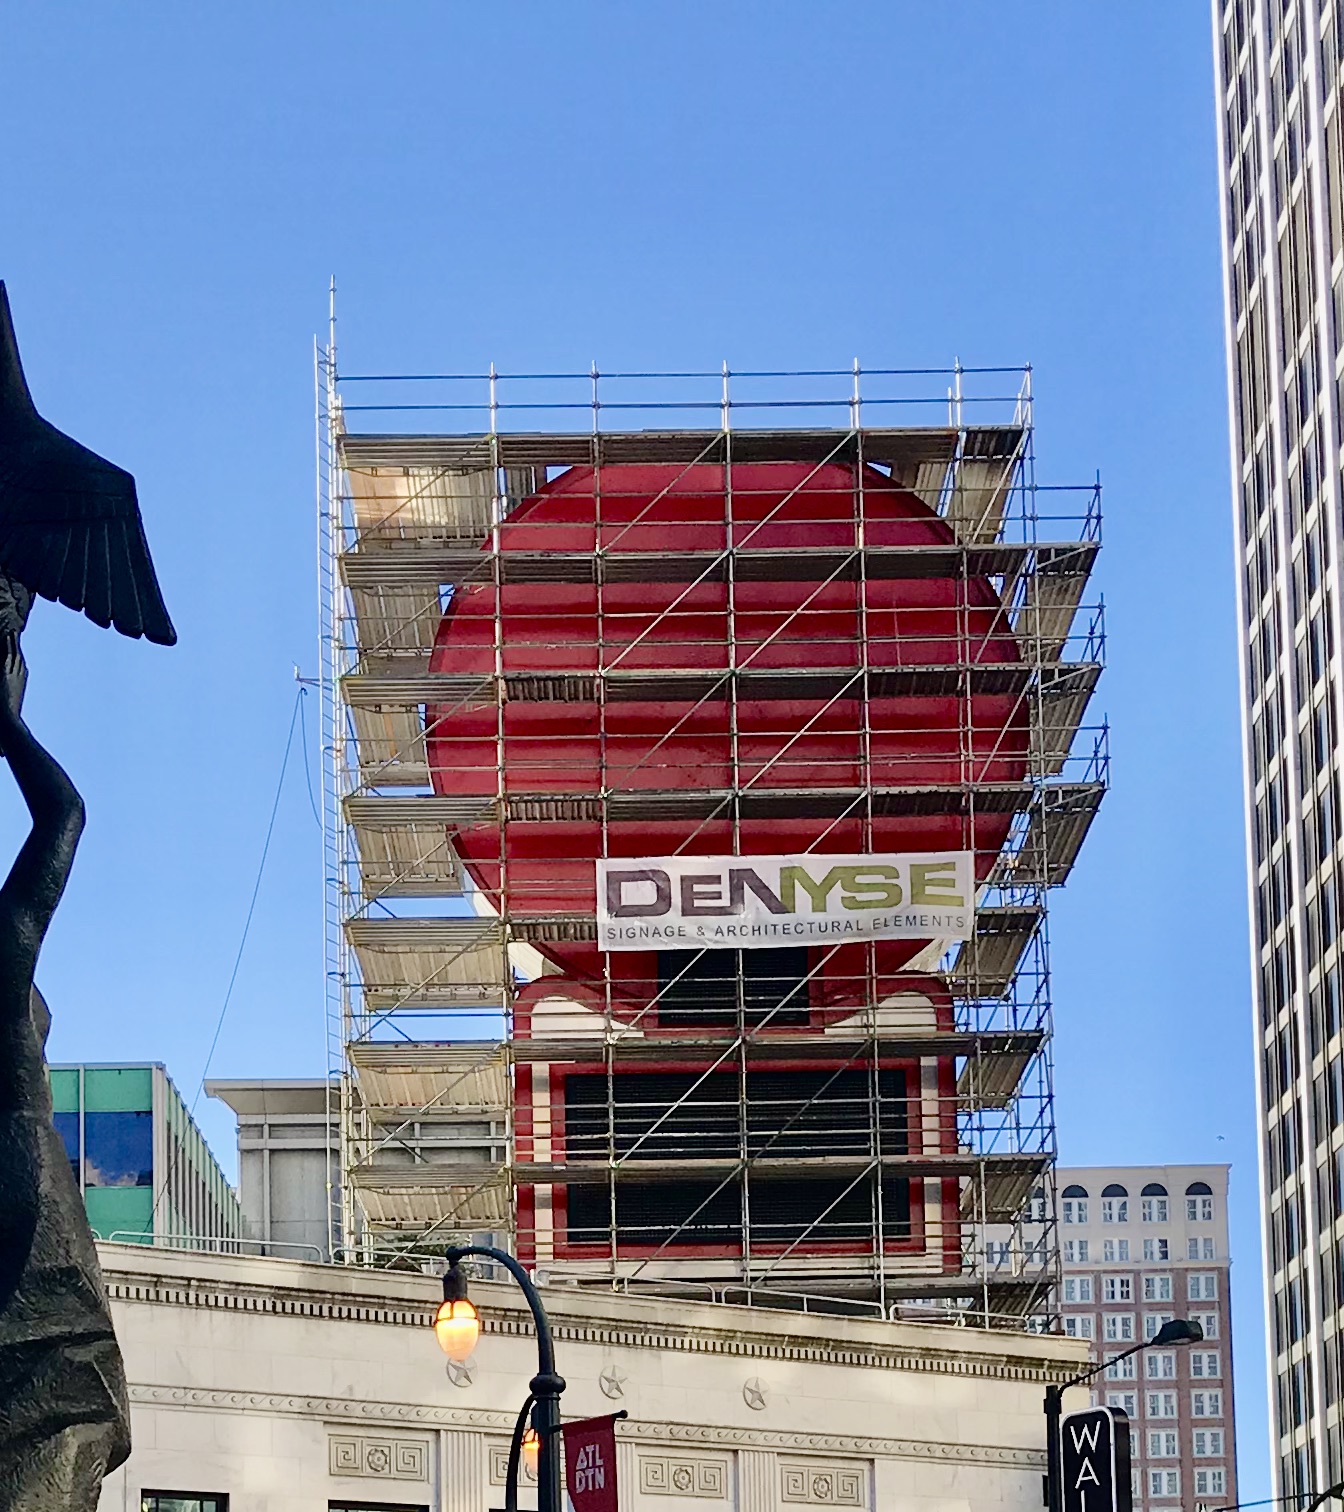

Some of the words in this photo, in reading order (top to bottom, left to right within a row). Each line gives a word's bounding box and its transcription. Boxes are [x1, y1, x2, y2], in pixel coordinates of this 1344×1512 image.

[605, 861, 965, 919] DENYSE
[606, 924, 688, 940] SIGNAGE
[696, 925, 707, 938] &
[714, 918, 864, 938] ARCHITECTURAL
[872, 913, 965, 931] ELEMENTS
[576, 1443, 604, 1470] ATL
[575, 1467, 605, 1494] DTN
